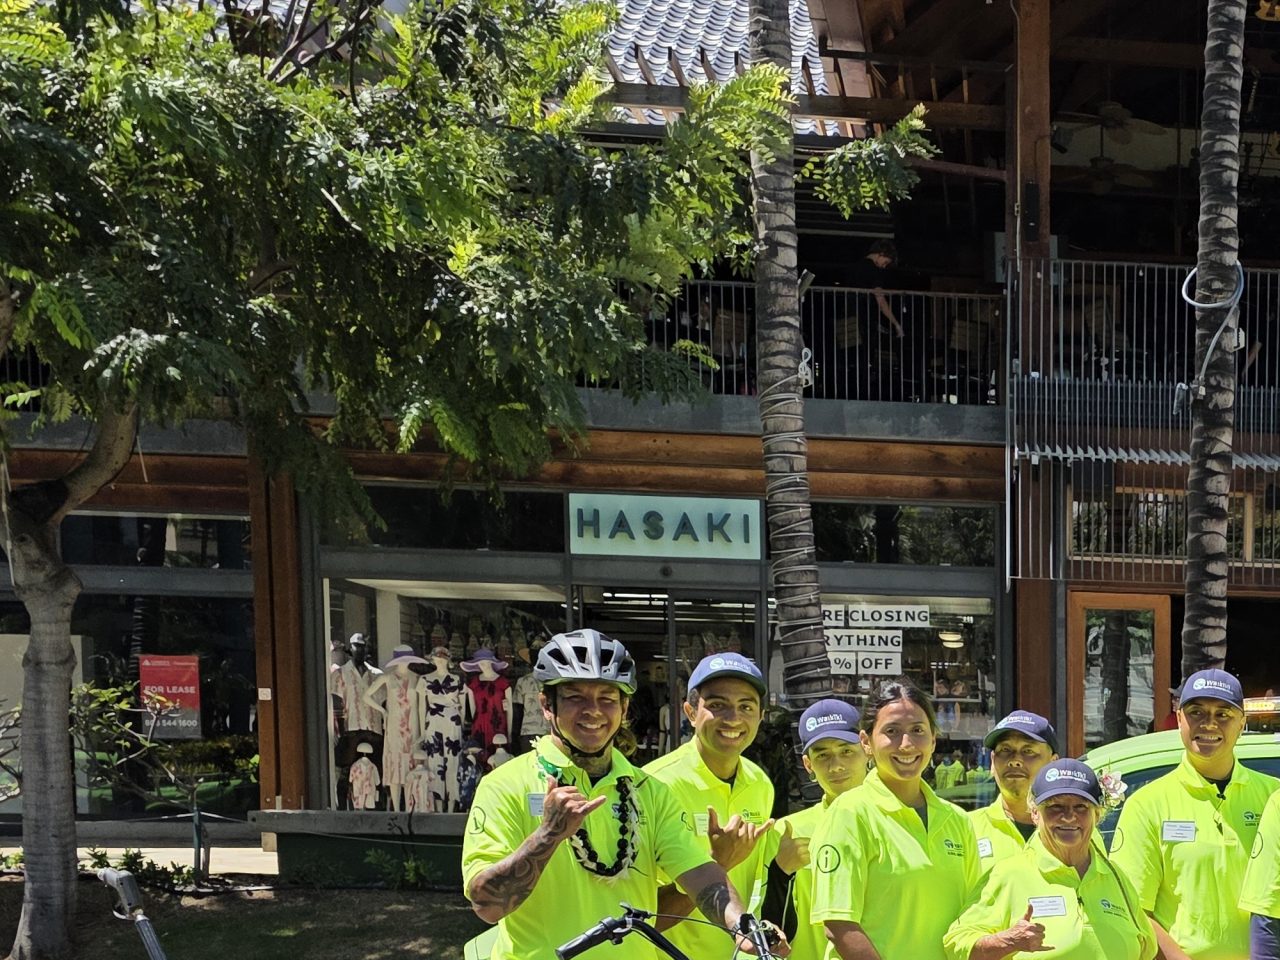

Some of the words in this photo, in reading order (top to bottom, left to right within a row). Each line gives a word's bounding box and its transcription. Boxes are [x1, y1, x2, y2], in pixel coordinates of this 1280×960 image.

[577, 508, 750, 544] HASAKI
[849, 610, 928, 622] CLOSING
[861, 658, 893, 670] OFF
[145, 686, 164, 694] FOR
[166, 686, 195, 694] LEASE
